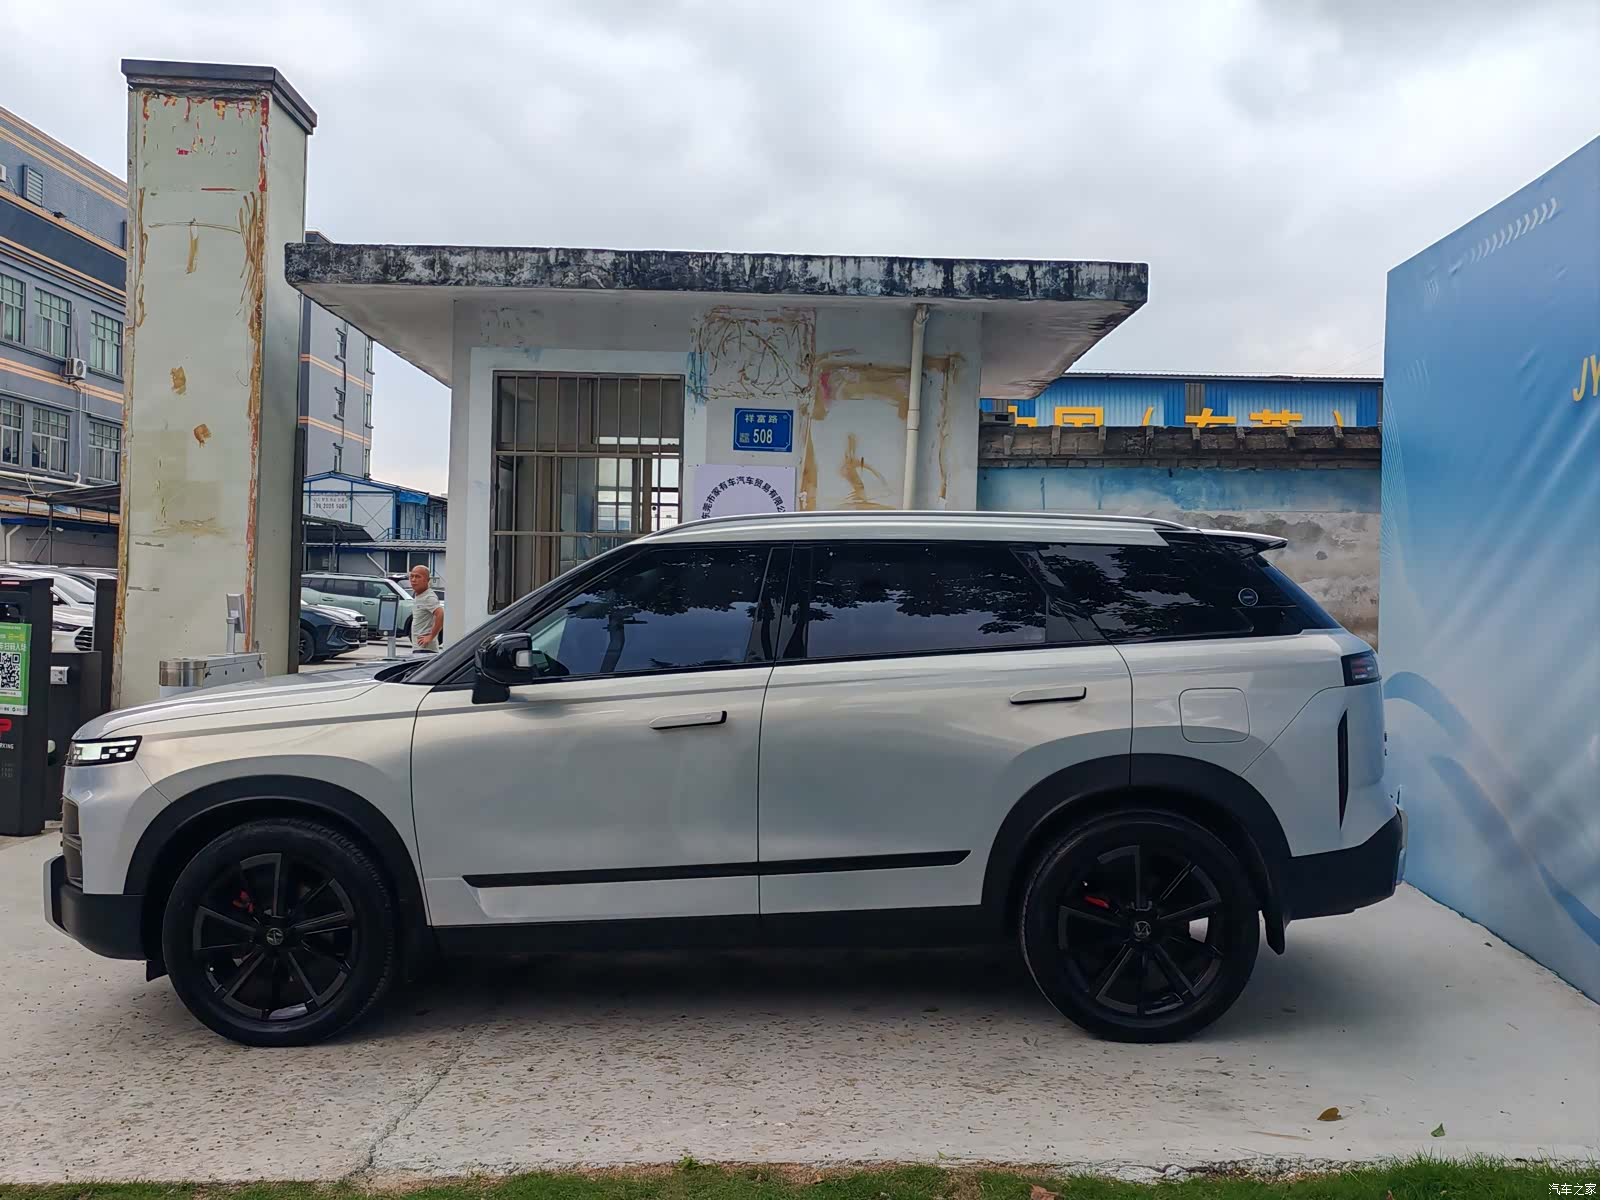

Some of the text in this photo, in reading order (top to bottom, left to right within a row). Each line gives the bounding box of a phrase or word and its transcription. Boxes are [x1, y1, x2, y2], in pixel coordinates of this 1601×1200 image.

[745, 414, 778, 424] 祥富路
[753, 428, 773, 444] 508
